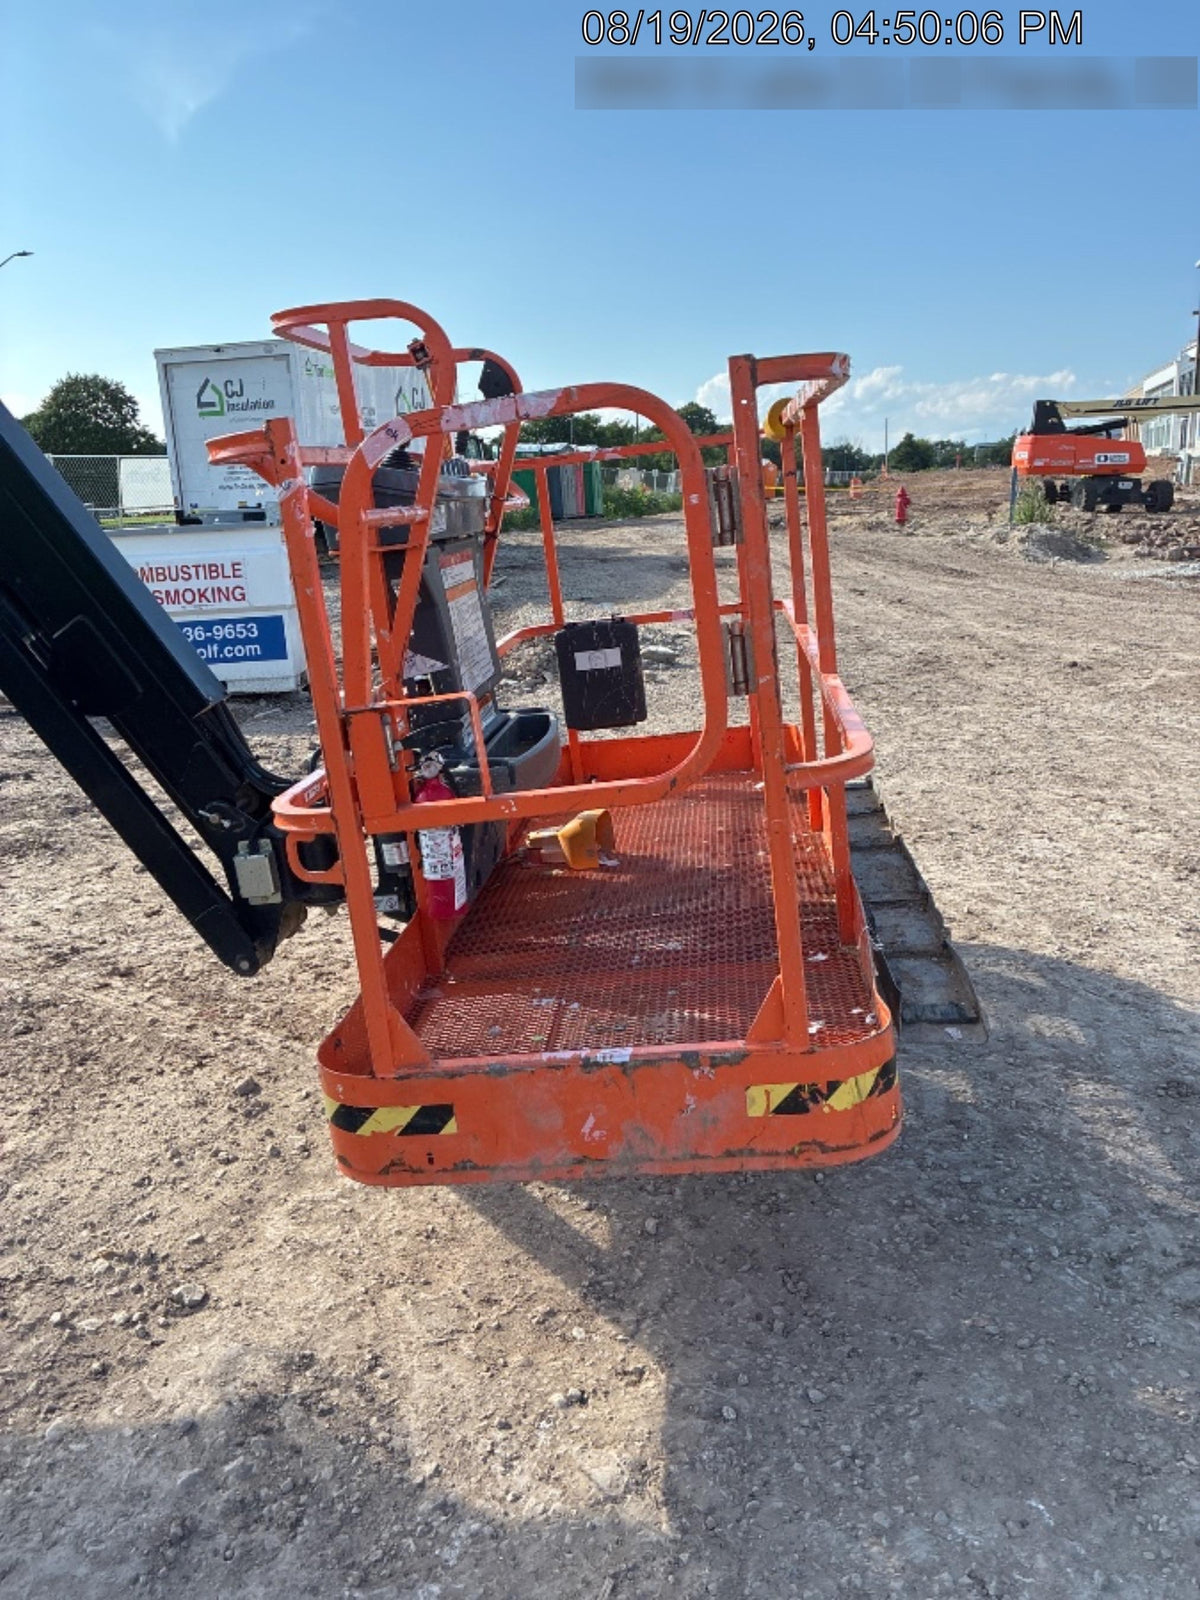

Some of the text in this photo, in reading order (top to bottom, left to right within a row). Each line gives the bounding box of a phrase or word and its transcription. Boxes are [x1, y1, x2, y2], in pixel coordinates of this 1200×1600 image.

[224, 378, 245, 399] CJ
[226, 398, 276, 412] Insulation
[135, 561, 243, 584] MBUSTIBLE
[152, 586, 246, 606] SMOKING
[182, 622, 259, 643] 36-9653
